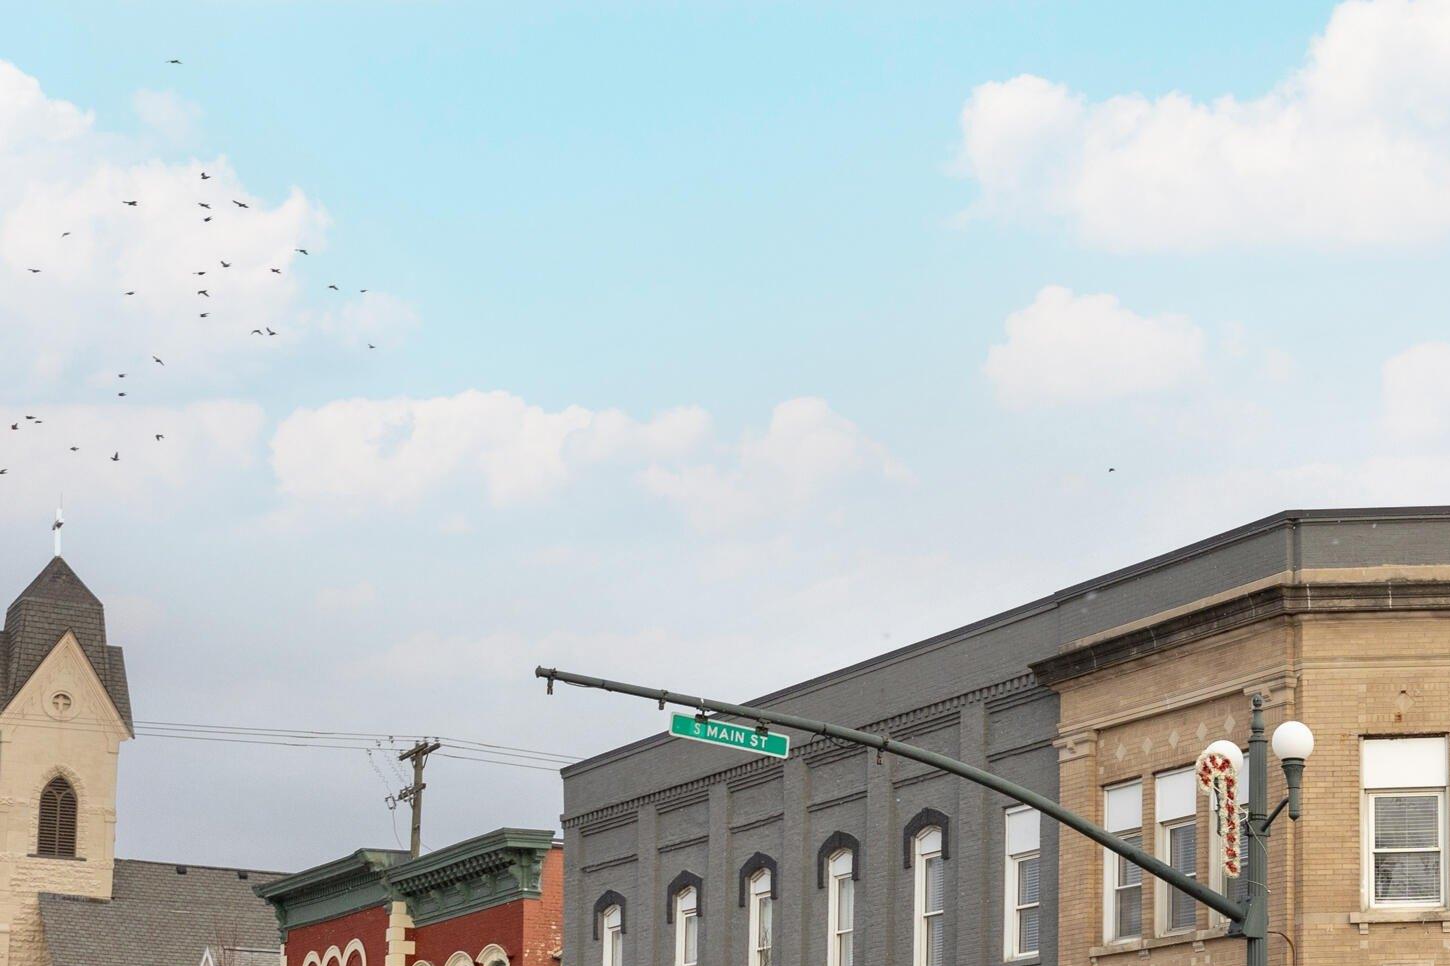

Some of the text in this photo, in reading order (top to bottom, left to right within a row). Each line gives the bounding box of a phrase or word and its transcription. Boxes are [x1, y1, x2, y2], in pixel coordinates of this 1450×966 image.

[694, 723, 768, 749] S MAIN ST
